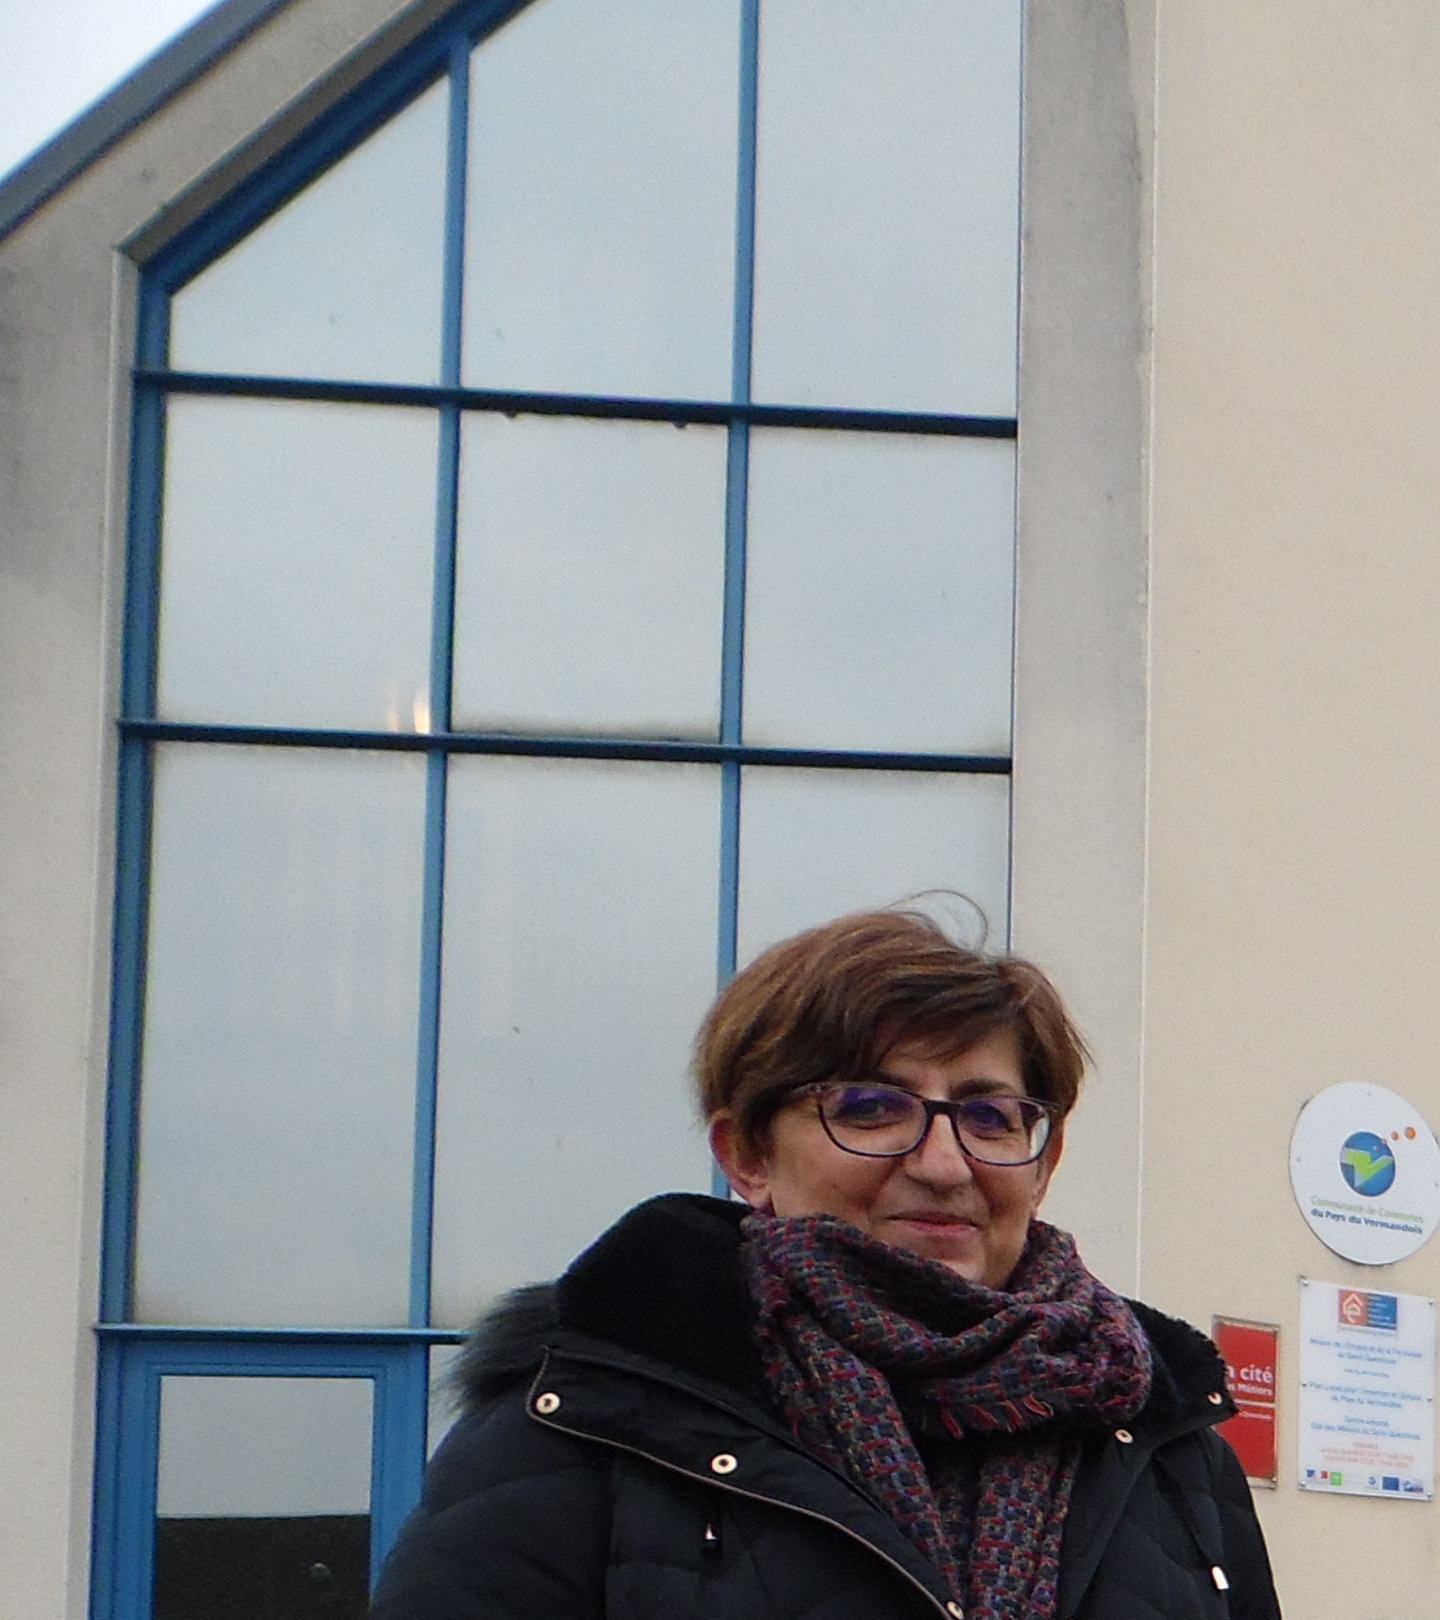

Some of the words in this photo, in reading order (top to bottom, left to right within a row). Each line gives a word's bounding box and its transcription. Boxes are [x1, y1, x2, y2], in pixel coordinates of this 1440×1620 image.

[1311, 1208, 1323, 1218] du
[1325, 1211, 1346, 1223] Pays
[1348, 1215, 1361, 1224] du
[1363, 1217, 1423, 1234] Vermandois
[1240, 1363, 1273, 1384] cité
